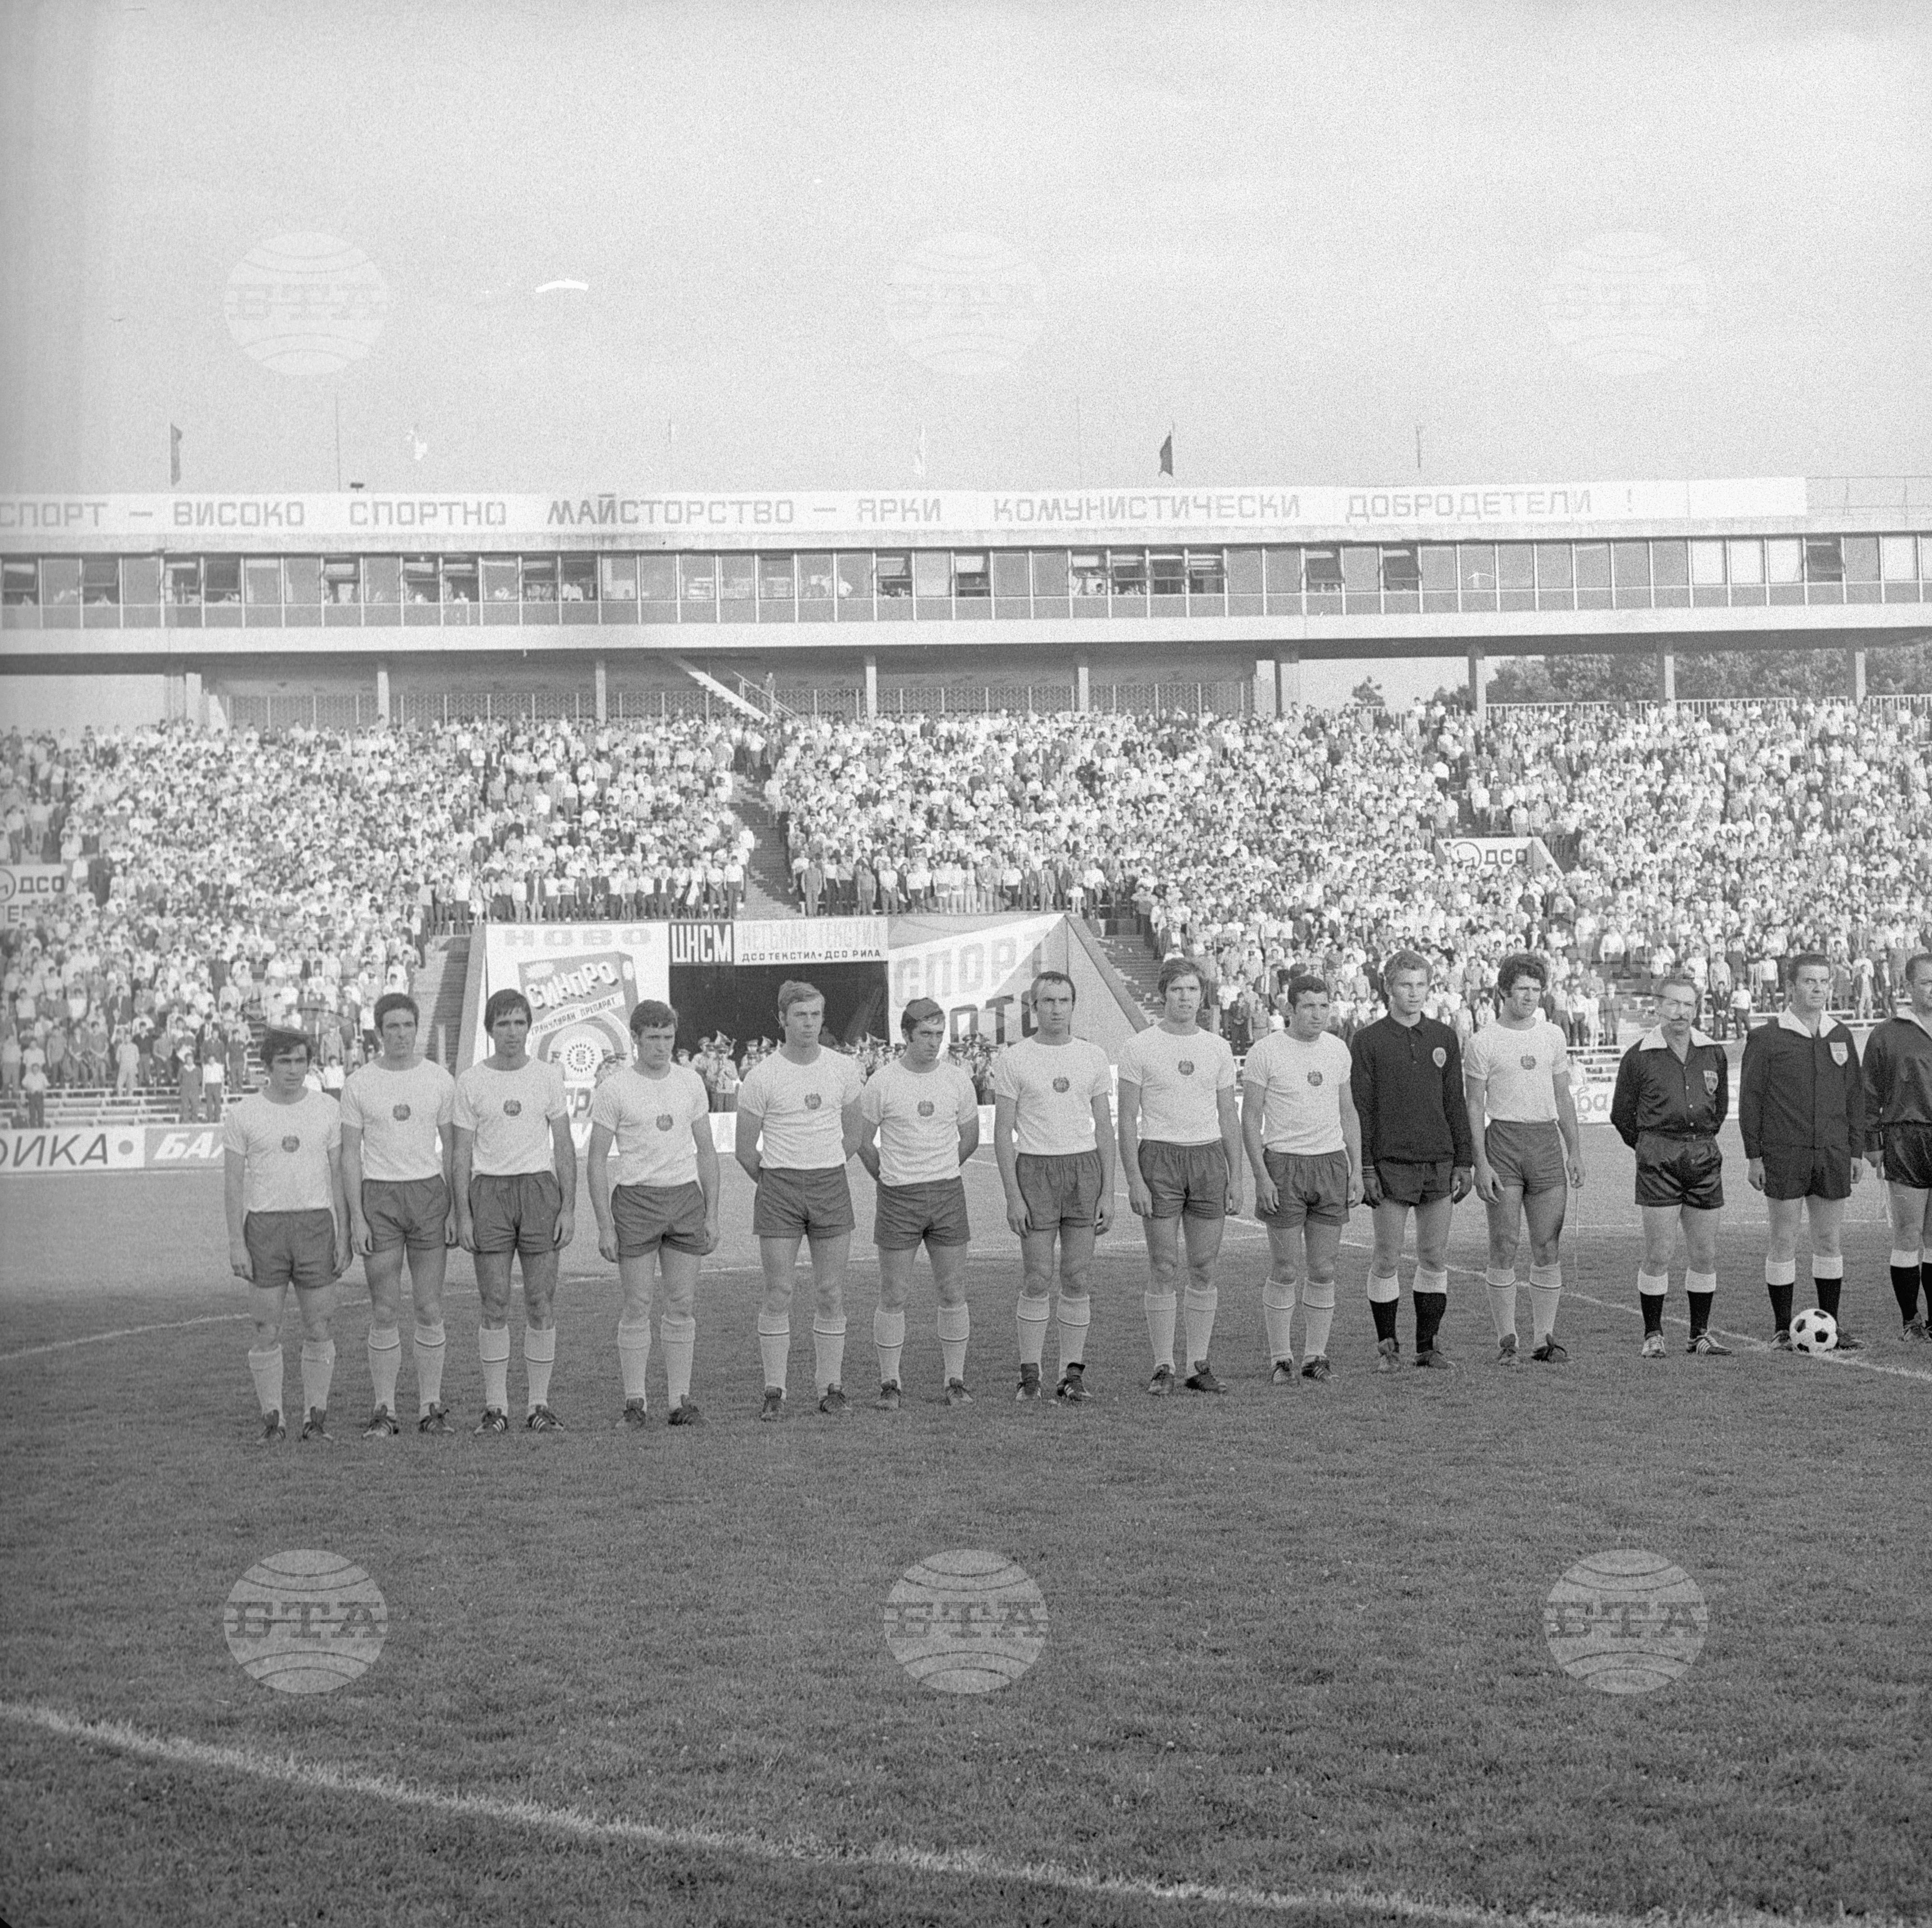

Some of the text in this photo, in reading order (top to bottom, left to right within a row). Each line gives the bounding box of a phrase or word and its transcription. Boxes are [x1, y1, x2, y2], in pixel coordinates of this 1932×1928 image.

[0, 501, 107, 528] СПОРТ
[173, 500, 305, 526] ВИСОКО
[349, 500, 507, 527] СПОРТНО
[546, 493, 795, 525] МАЙСТОРСТВО
[856, 498, 942, 523] ЯРКИ
[993, 493, 1301, 522] КОМУНИСТИЧЕСКИ
[1344, 488, 1592, 524] ДОБРОДЕТЕЛИ
[1484, 848, 1527, 865] ДСО
[18, 876, 65, 893] ДСО
[504, 928, 652, 946] НОВО
[670, 924, 732, 963] ЦНСМ
[742, 949, 881, 962] ДСО ТЕКСТИЛ ДСО РИЛА
[581, 997, 616, 1017] ПРЕПАРАТ
